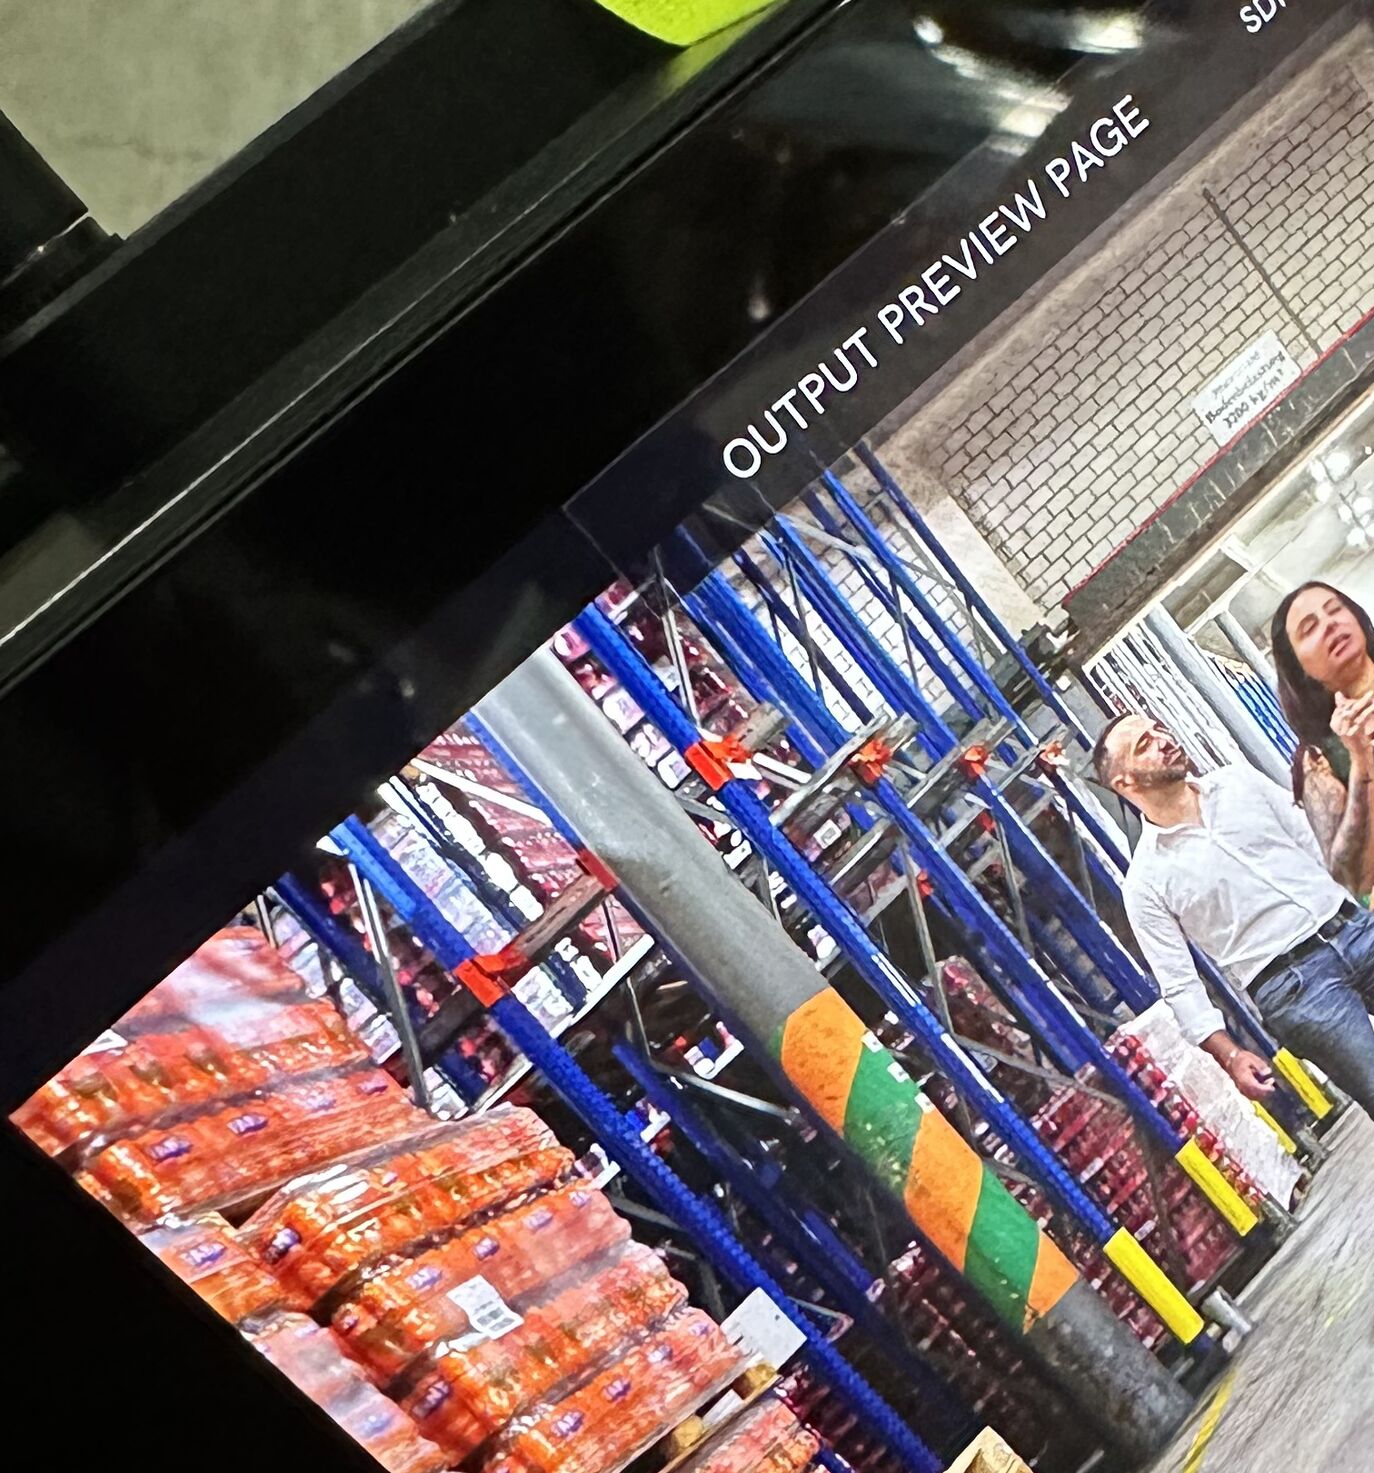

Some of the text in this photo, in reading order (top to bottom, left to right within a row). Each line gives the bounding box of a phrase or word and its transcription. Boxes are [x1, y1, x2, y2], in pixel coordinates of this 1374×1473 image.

[1239, 0, 1287, 33] SD
[723, 94, 1150, 479] OUTPUT PREVIEW PAGE
